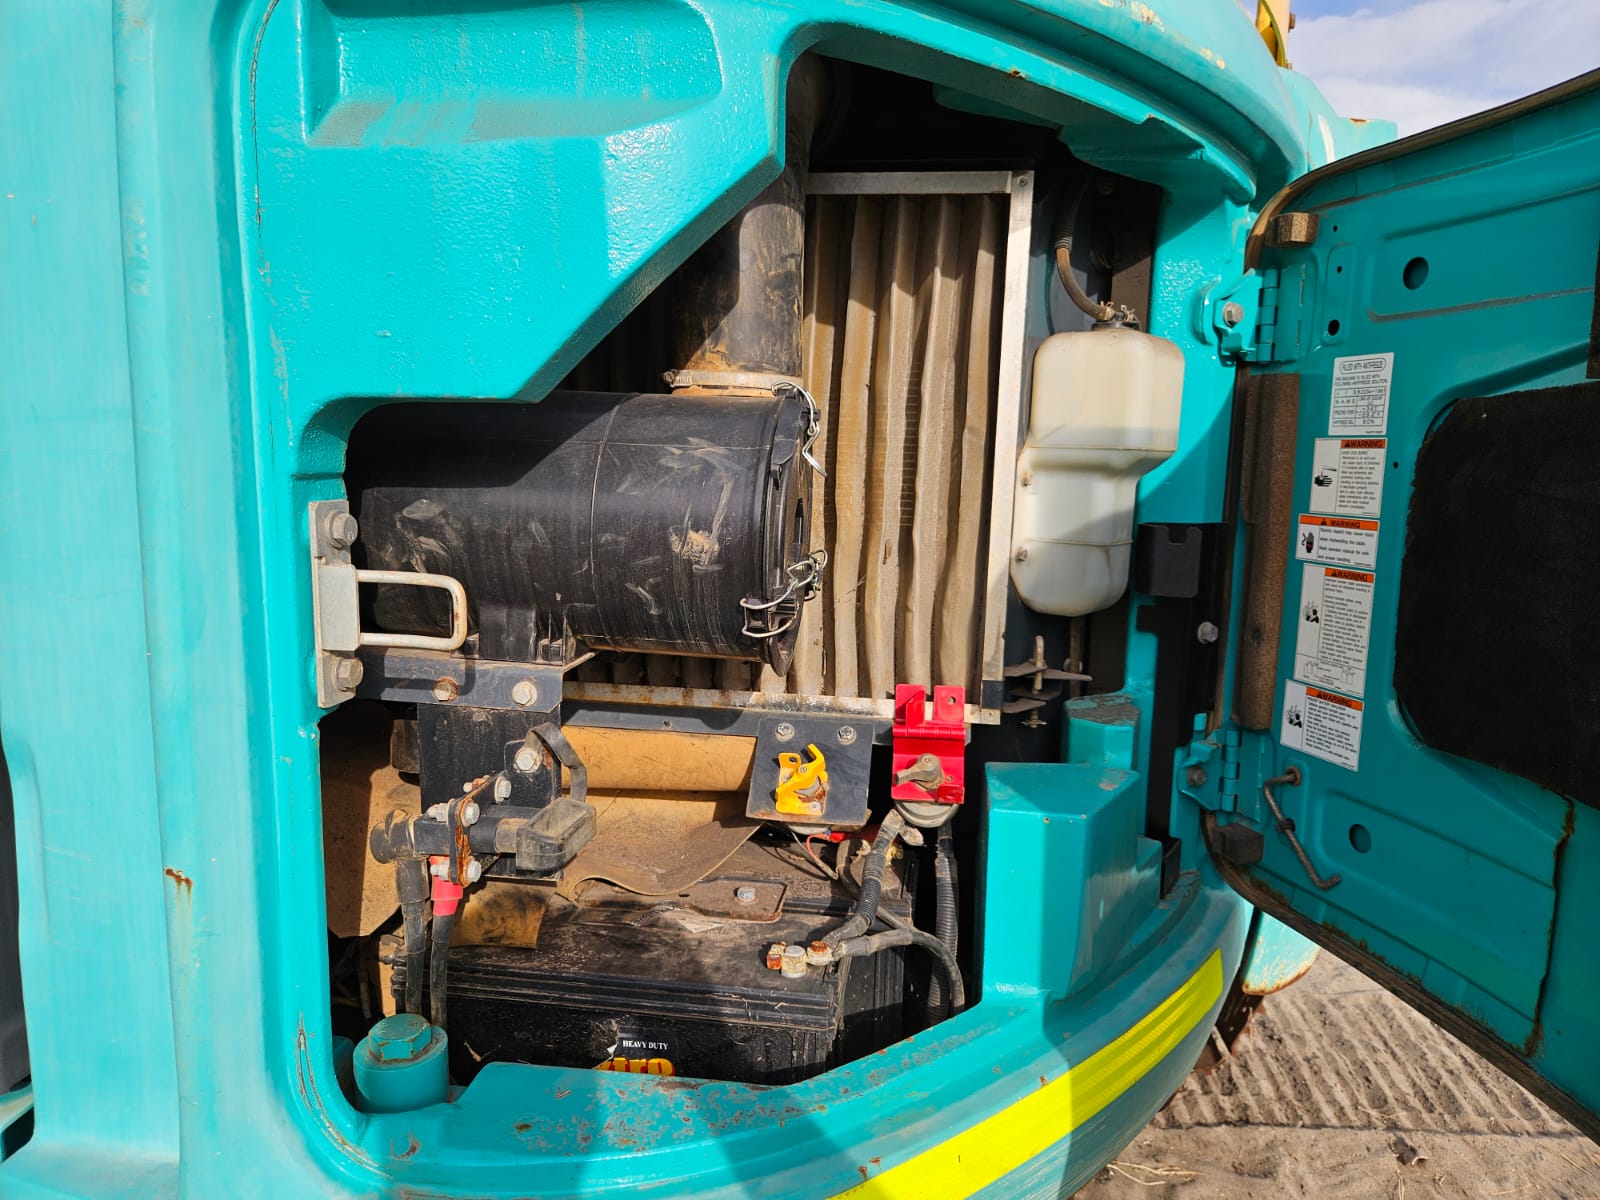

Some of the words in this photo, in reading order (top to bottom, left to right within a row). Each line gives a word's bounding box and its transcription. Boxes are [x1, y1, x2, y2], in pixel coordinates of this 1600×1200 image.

[1350, 440, 1383, 448] WARNING
[1330, 519, 1361, 529] WARNING
[1336, 569, 1368, 582] WARNING
[1322, 691, 1352, 708] WARNING
[622, 1039, 647, 1049] HEAVY
[648, 1042, 669, 1050] DUTY
